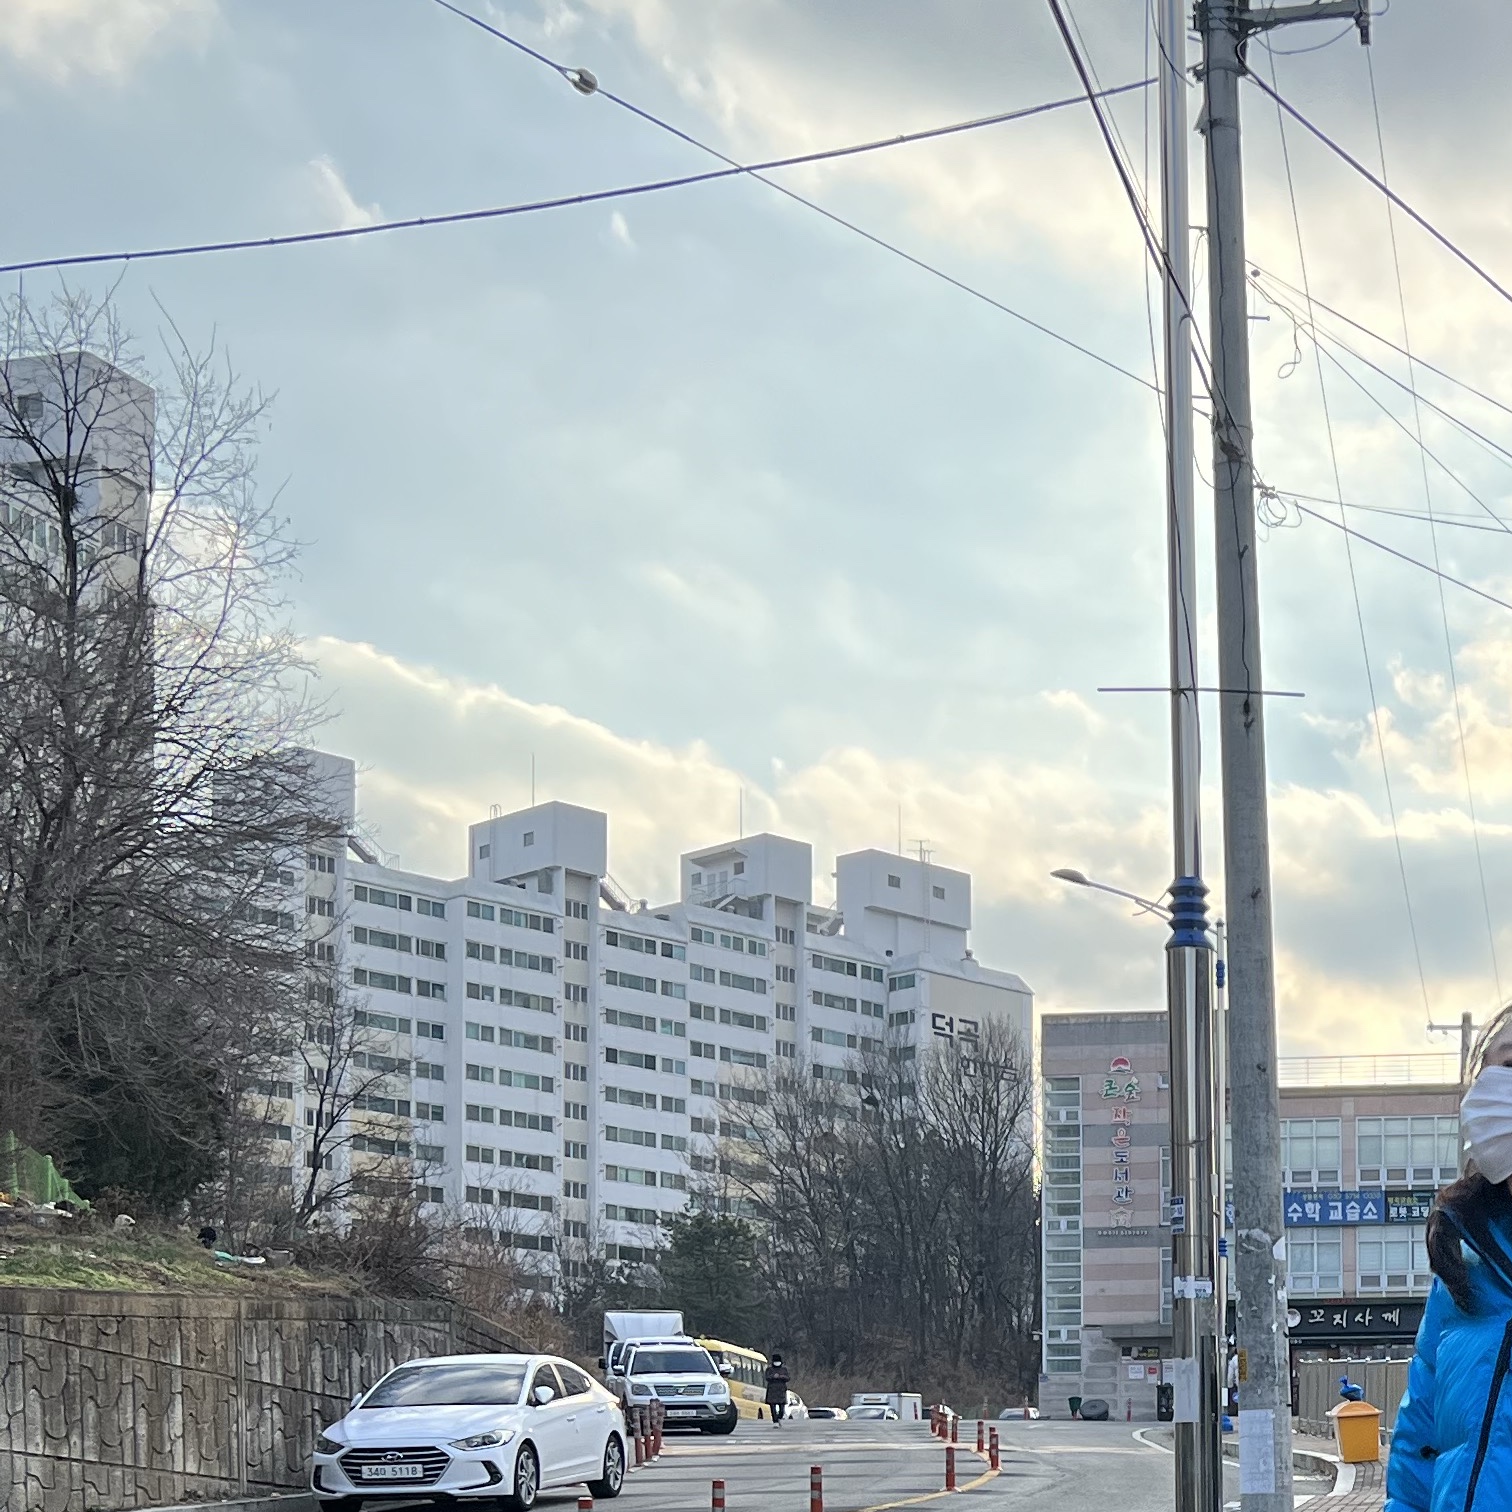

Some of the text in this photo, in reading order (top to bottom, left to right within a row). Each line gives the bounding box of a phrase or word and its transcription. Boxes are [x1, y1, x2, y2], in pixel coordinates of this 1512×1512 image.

[931, 1012, 980, 1053] 덕곡
[1101, 1077, 1141, 1102] 큰숲
[1287, 1202, 1321, 1223] 수학
[1328, 1201, 1379, 1222] 교습소
[391, 1466, 418, 1476] 5118
